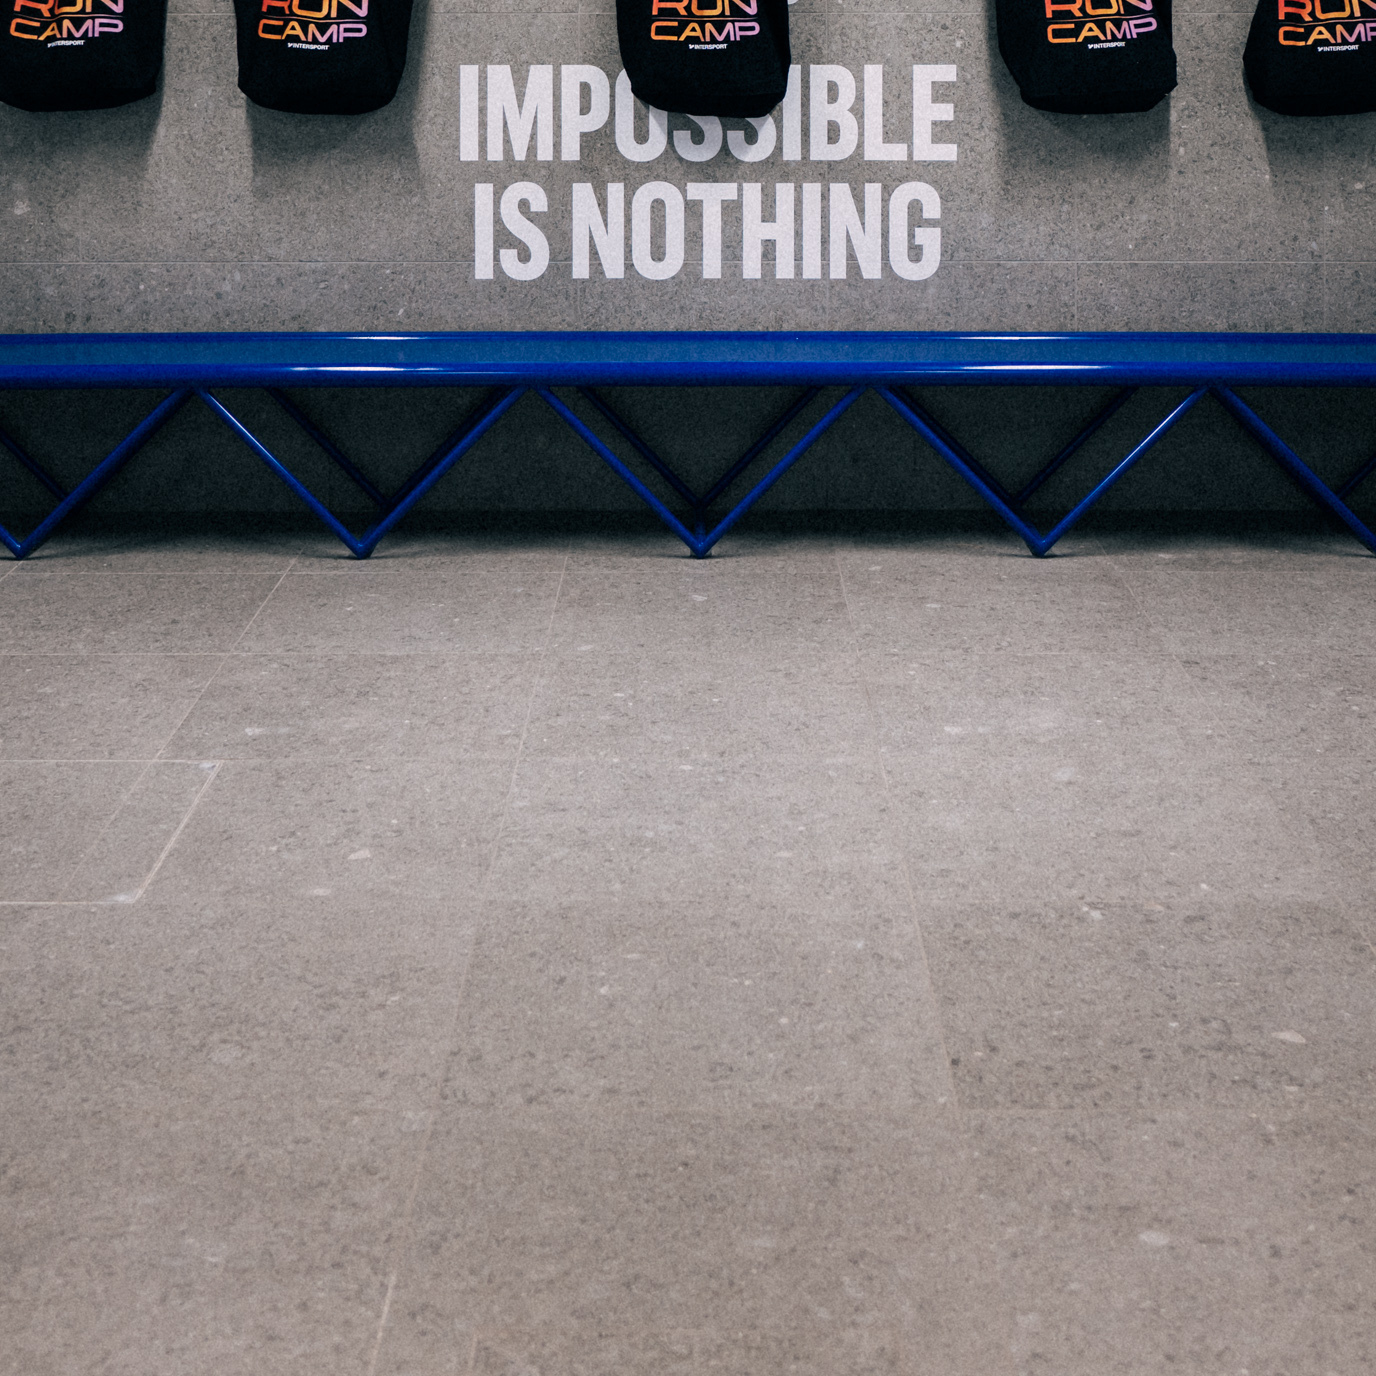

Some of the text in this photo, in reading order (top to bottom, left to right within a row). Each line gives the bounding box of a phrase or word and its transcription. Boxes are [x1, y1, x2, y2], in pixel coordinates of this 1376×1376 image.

[10, 18, 124, 41] CAMP
[258, 19, 367, 43] CAMP
[650, 21, 760, 42] CAMP
[1047, 17, 1157, 44] CAMP
[293, 43, 329, 51] INTERSPORT
[475, 181, 941, 280] IS NOTHING
